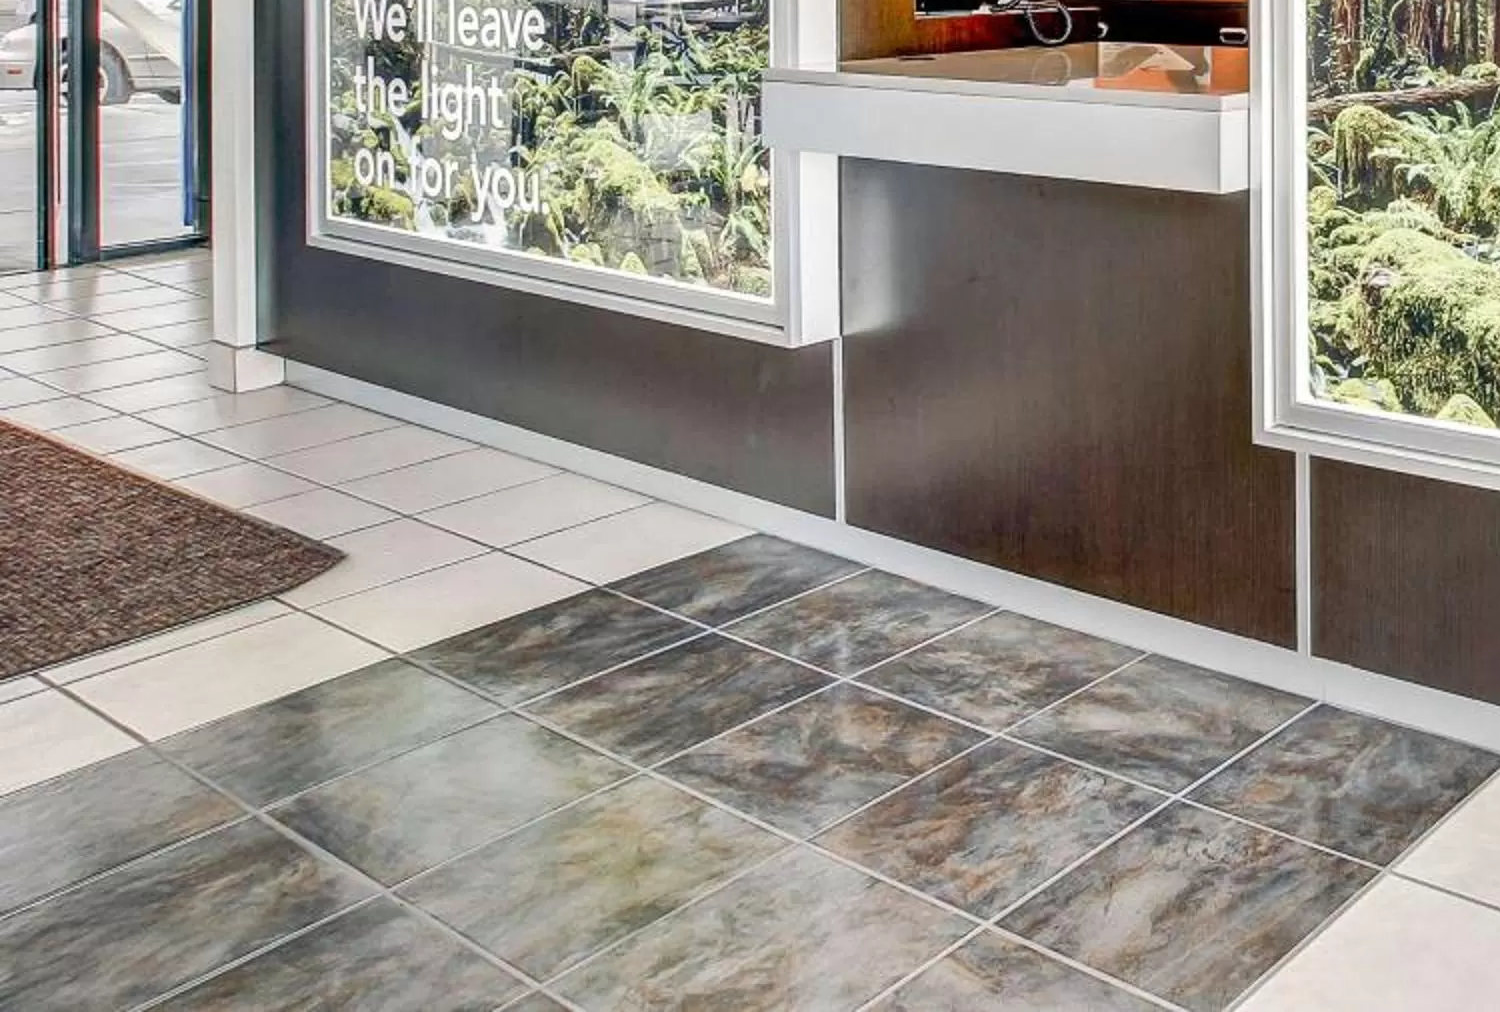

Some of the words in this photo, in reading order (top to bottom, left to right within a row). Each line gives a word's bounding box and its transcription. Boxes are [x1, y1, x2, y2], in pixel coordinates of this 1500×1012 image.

[354, 55, 410, 117] the
[421, 59, 506, 141] light
[355, 146, 396, 188] on
[409, 135, 459, 199] for
[471, 161, 551, 222] you.
